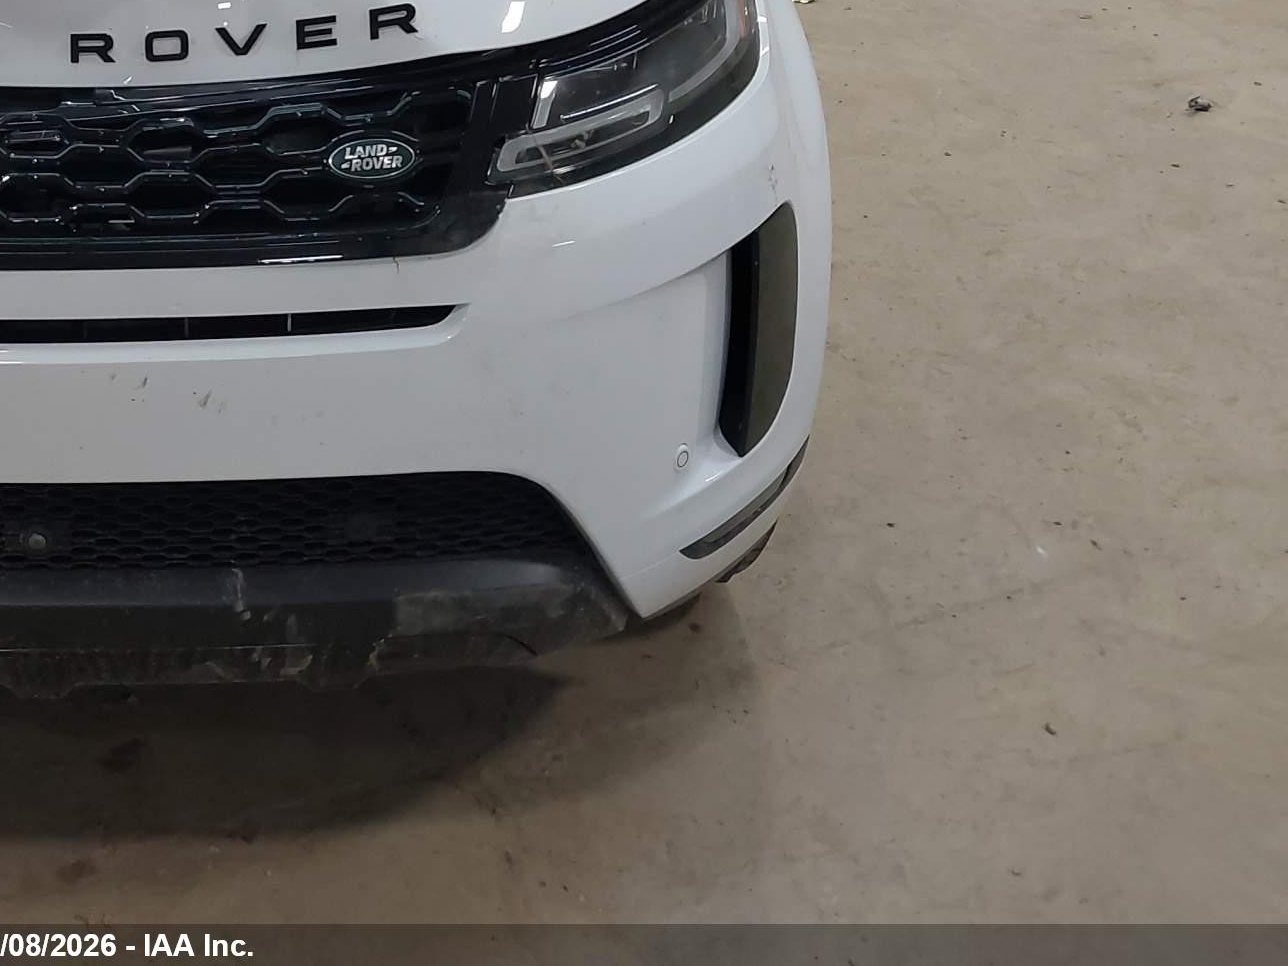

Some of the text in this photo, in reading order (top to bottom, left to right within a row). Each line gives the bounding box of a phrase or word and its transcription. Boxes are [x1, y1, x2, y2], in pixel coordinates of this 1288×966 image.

[70, 1, 419, 64] ROVER
[344, 143, 387, 160] LAND
[350, 155, 403, 172] ROVER
